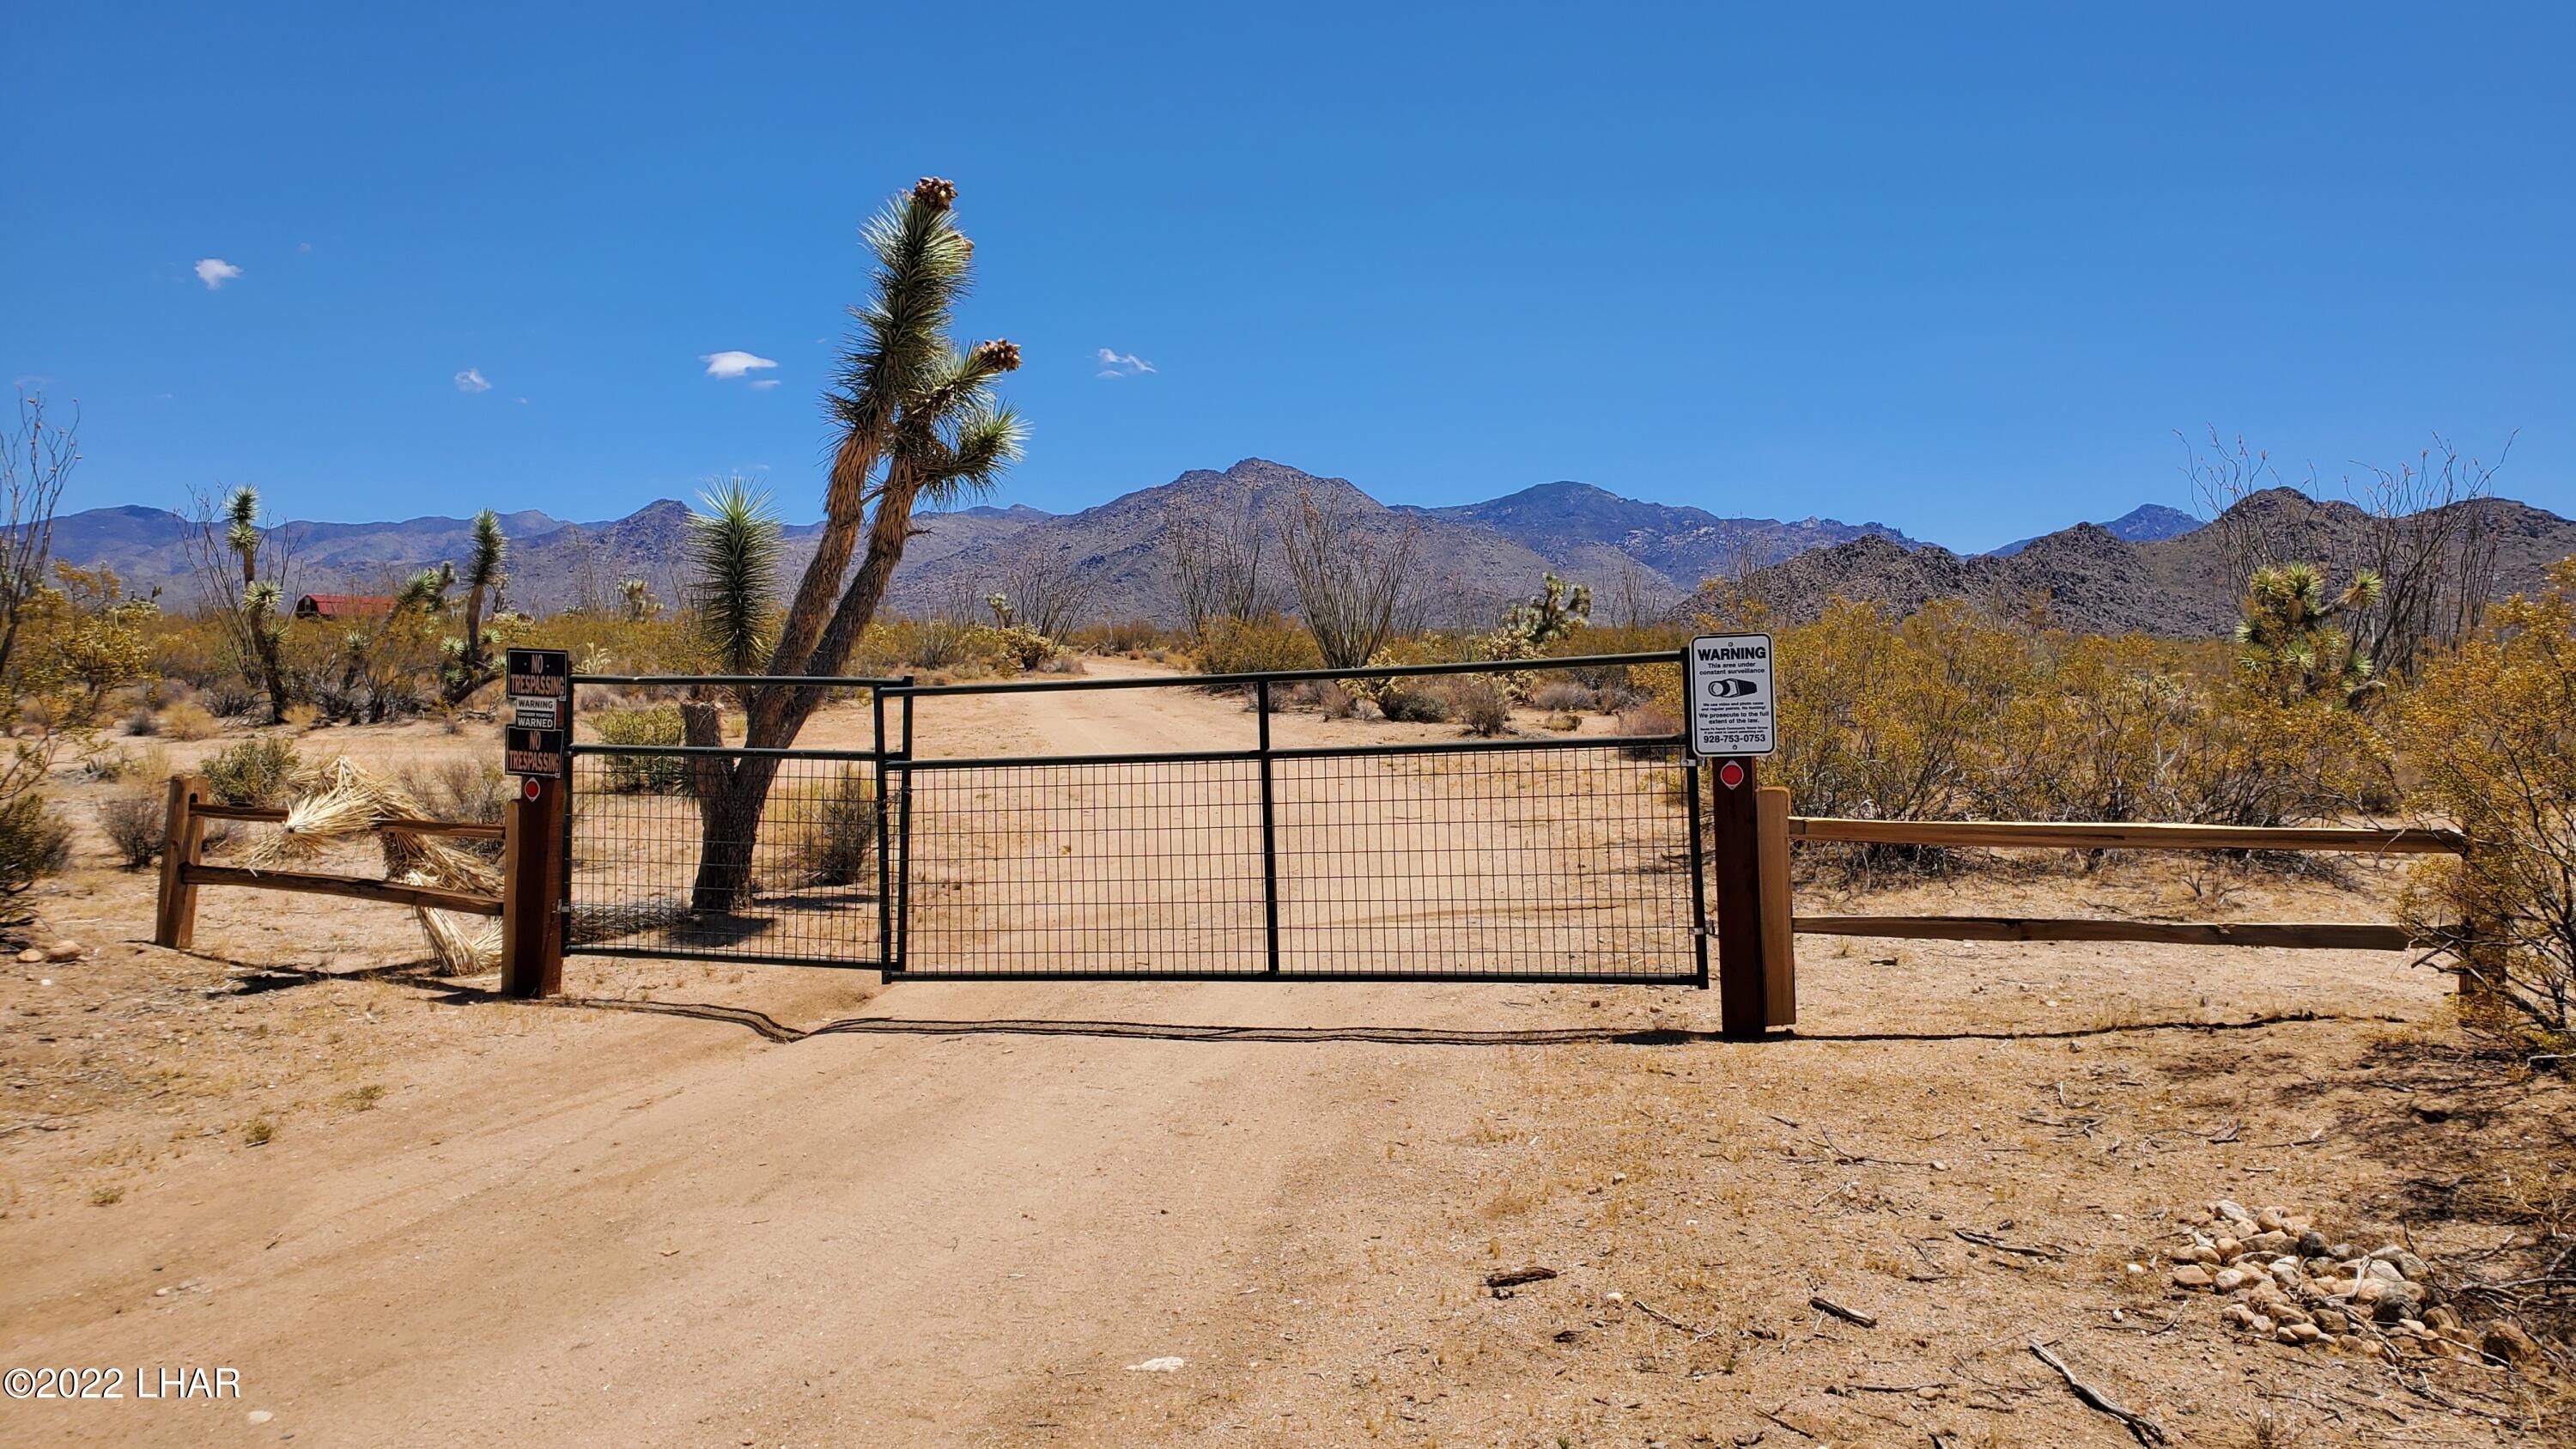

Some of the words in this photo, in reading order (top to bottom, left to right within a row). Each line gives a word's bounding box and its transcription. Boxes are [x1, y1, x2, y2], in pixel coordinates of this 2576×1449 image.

[1698, 646, 1766, 661] WARNING
[532, 654, 543, 673] NO
[511, 674, 564, 695] TRESPASSING
[518, 699, 553, 709] WARNING
[518, 717, 552, 728] WARNED
[529, 731, 541, 750] NO
[1704, 734, 1765, 743] 928-753-0753
[509, 750, 559, 772] TRESPASSING
